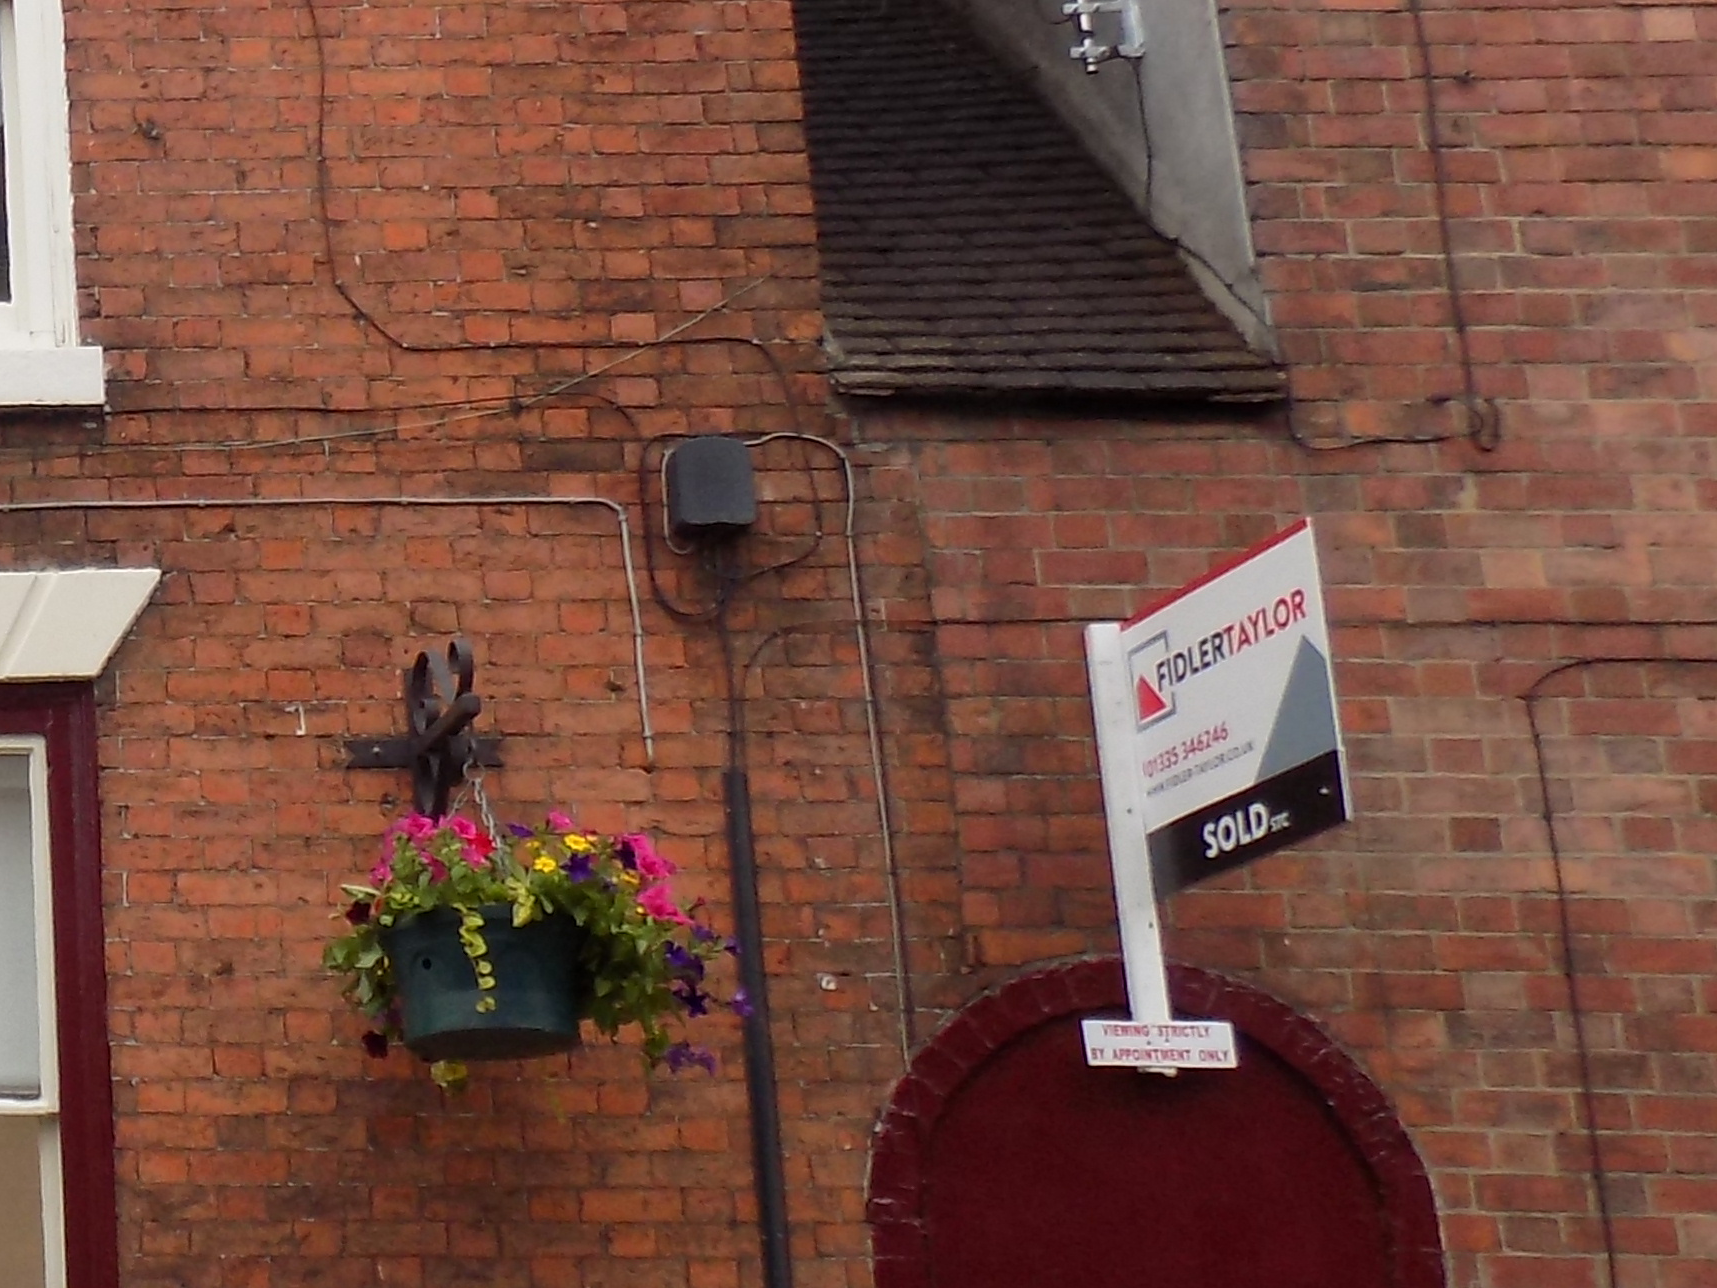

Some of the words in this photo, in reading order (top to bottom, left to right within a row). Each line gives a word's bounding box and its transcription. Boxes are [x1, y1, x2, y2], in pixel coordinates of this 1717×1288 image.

[1156, 588, 1307, 693] FIDLERTAYLOR
[1202, 802, 1267, 859] SOLD
[1102, 1024, 1150, 1037] VIEWING
[1158, 1024, 1210, 1038] STRICTLY
[1091, 1048, 1104, 1060] BY
[1112, 1048, 1191, 1061] APPOINTMENT
[1199, 1049, 1229, 1061] ONLY
